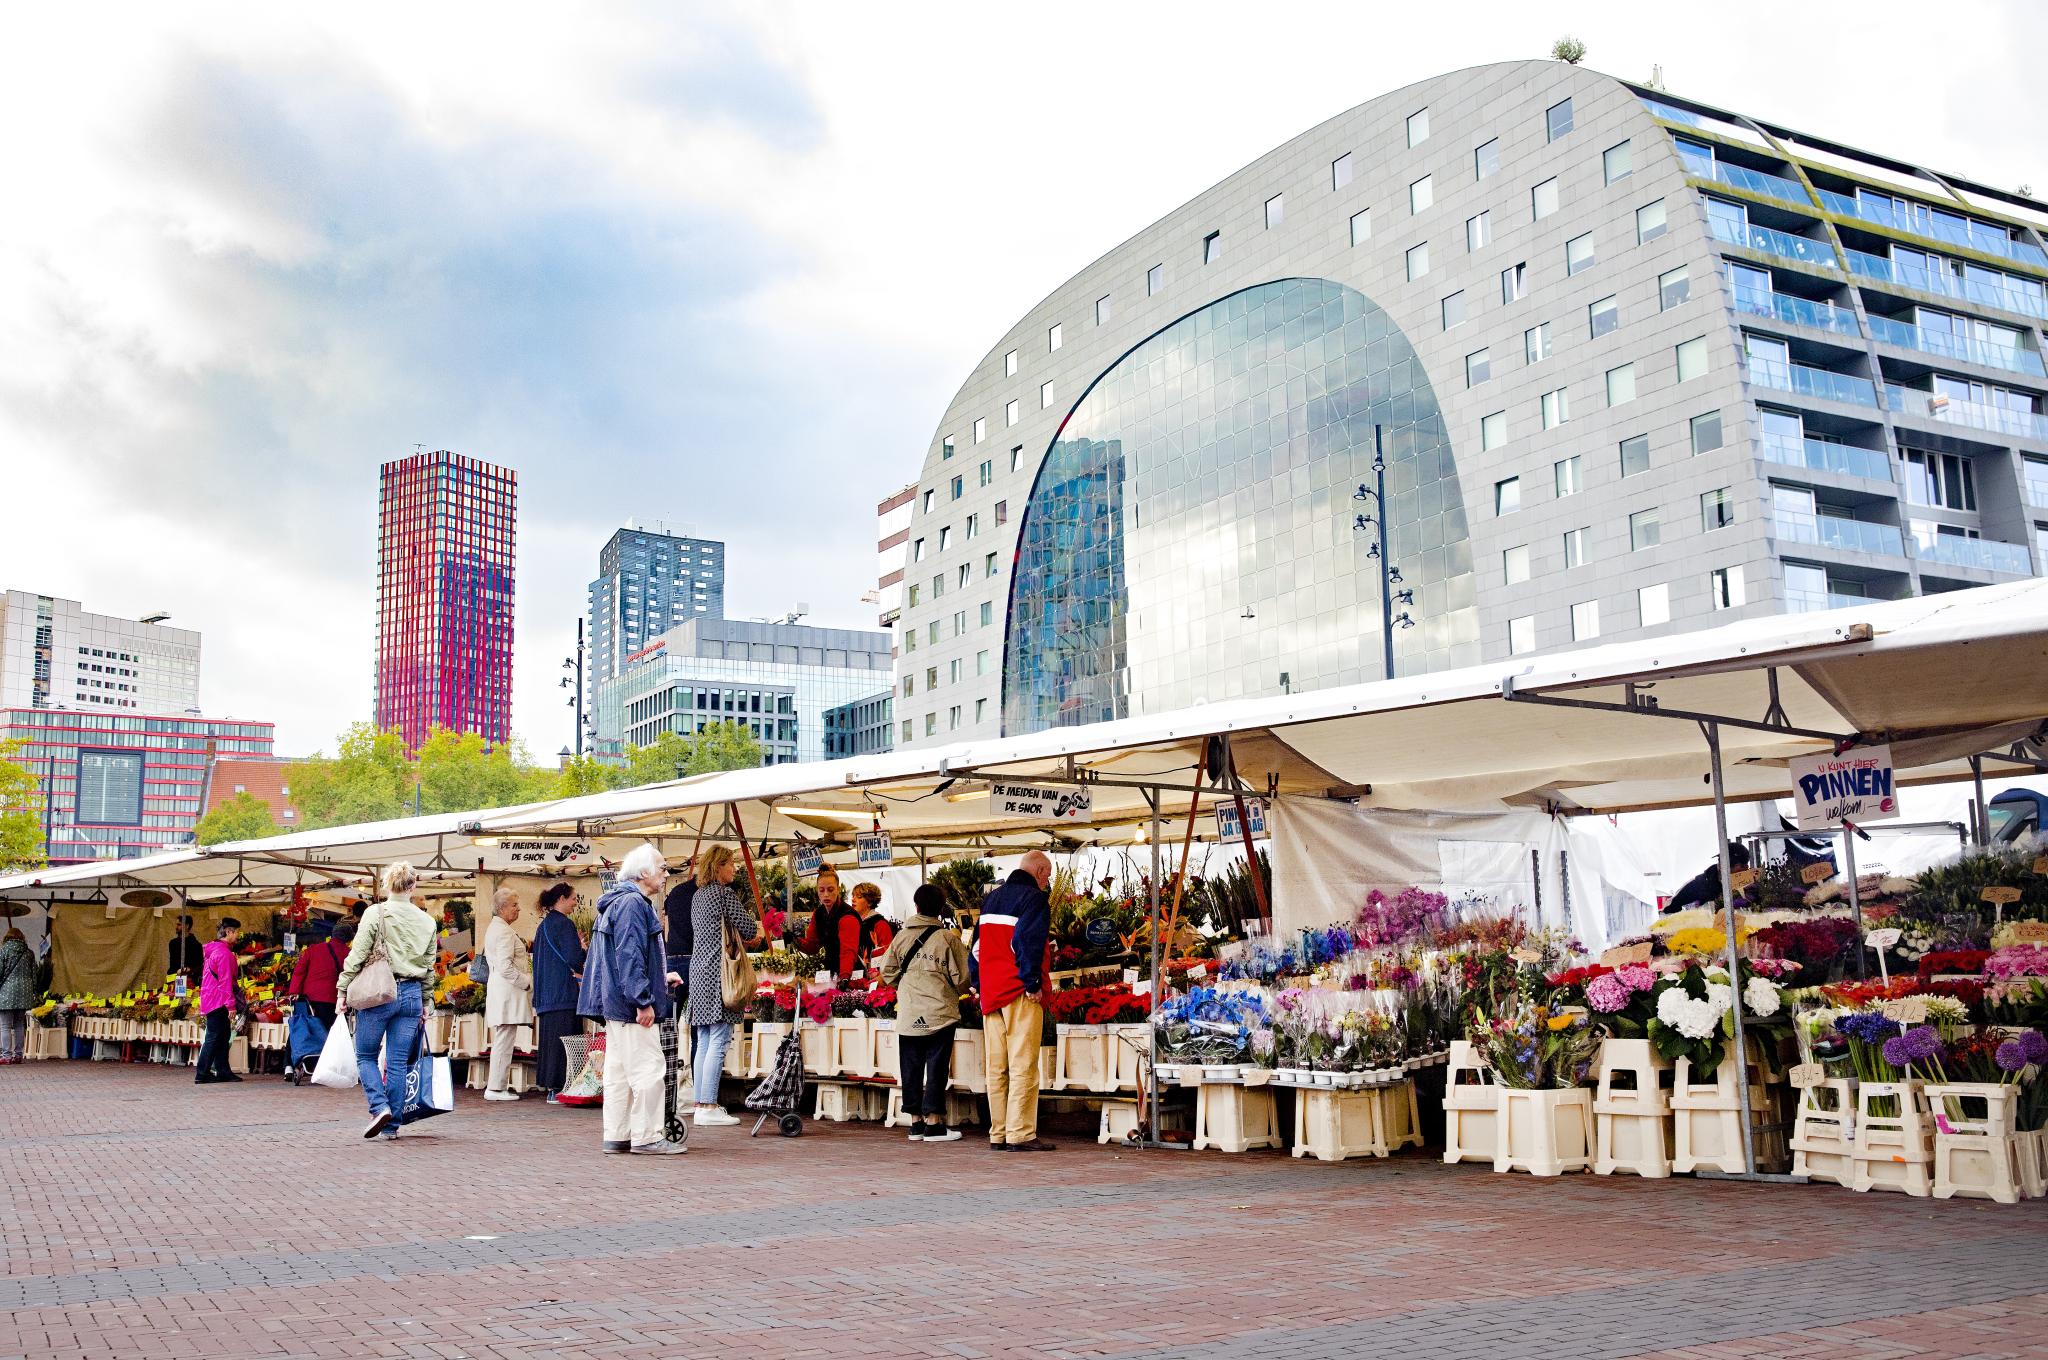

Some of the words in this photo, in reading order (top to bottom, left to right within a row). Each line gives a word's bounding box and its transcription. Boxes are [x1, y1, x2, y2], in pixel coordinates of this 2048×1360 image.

[1818, 765, 1825, 773] U
[1827, 761, 1851, 771] KUNT
[1853, 758, 1879, 769] HIER
[993, 785, 1005, 794] DE
[1006, 787, 1040, 799] MEIDEN
[1041, 789, 1058, 800] VAN
[1798, 767, 1891, 806] PINNEN
[1005, 801, 1016, 812] DE
[1018, 803, 1043, 813] SNOR
[1219, 805, 1250, 822] PINNN
[1826, 799, 1866, 821] welkom
[1222, 822, 1234, 836] JA
[1235, 817, 1264, 835] GAAG
[500, 842, 510, 850] DE
[512, 842, 542, 850] MEIDEN
[544, 842, 559, 850] VAN
[858, 838, 882, 850] PINNEN
[511, 853, 522, 861] DE
[523, 853, 546, 861] SNOR
[860, 850, 869, 862] JA
[869, 849, 891, 861] GRAAG
